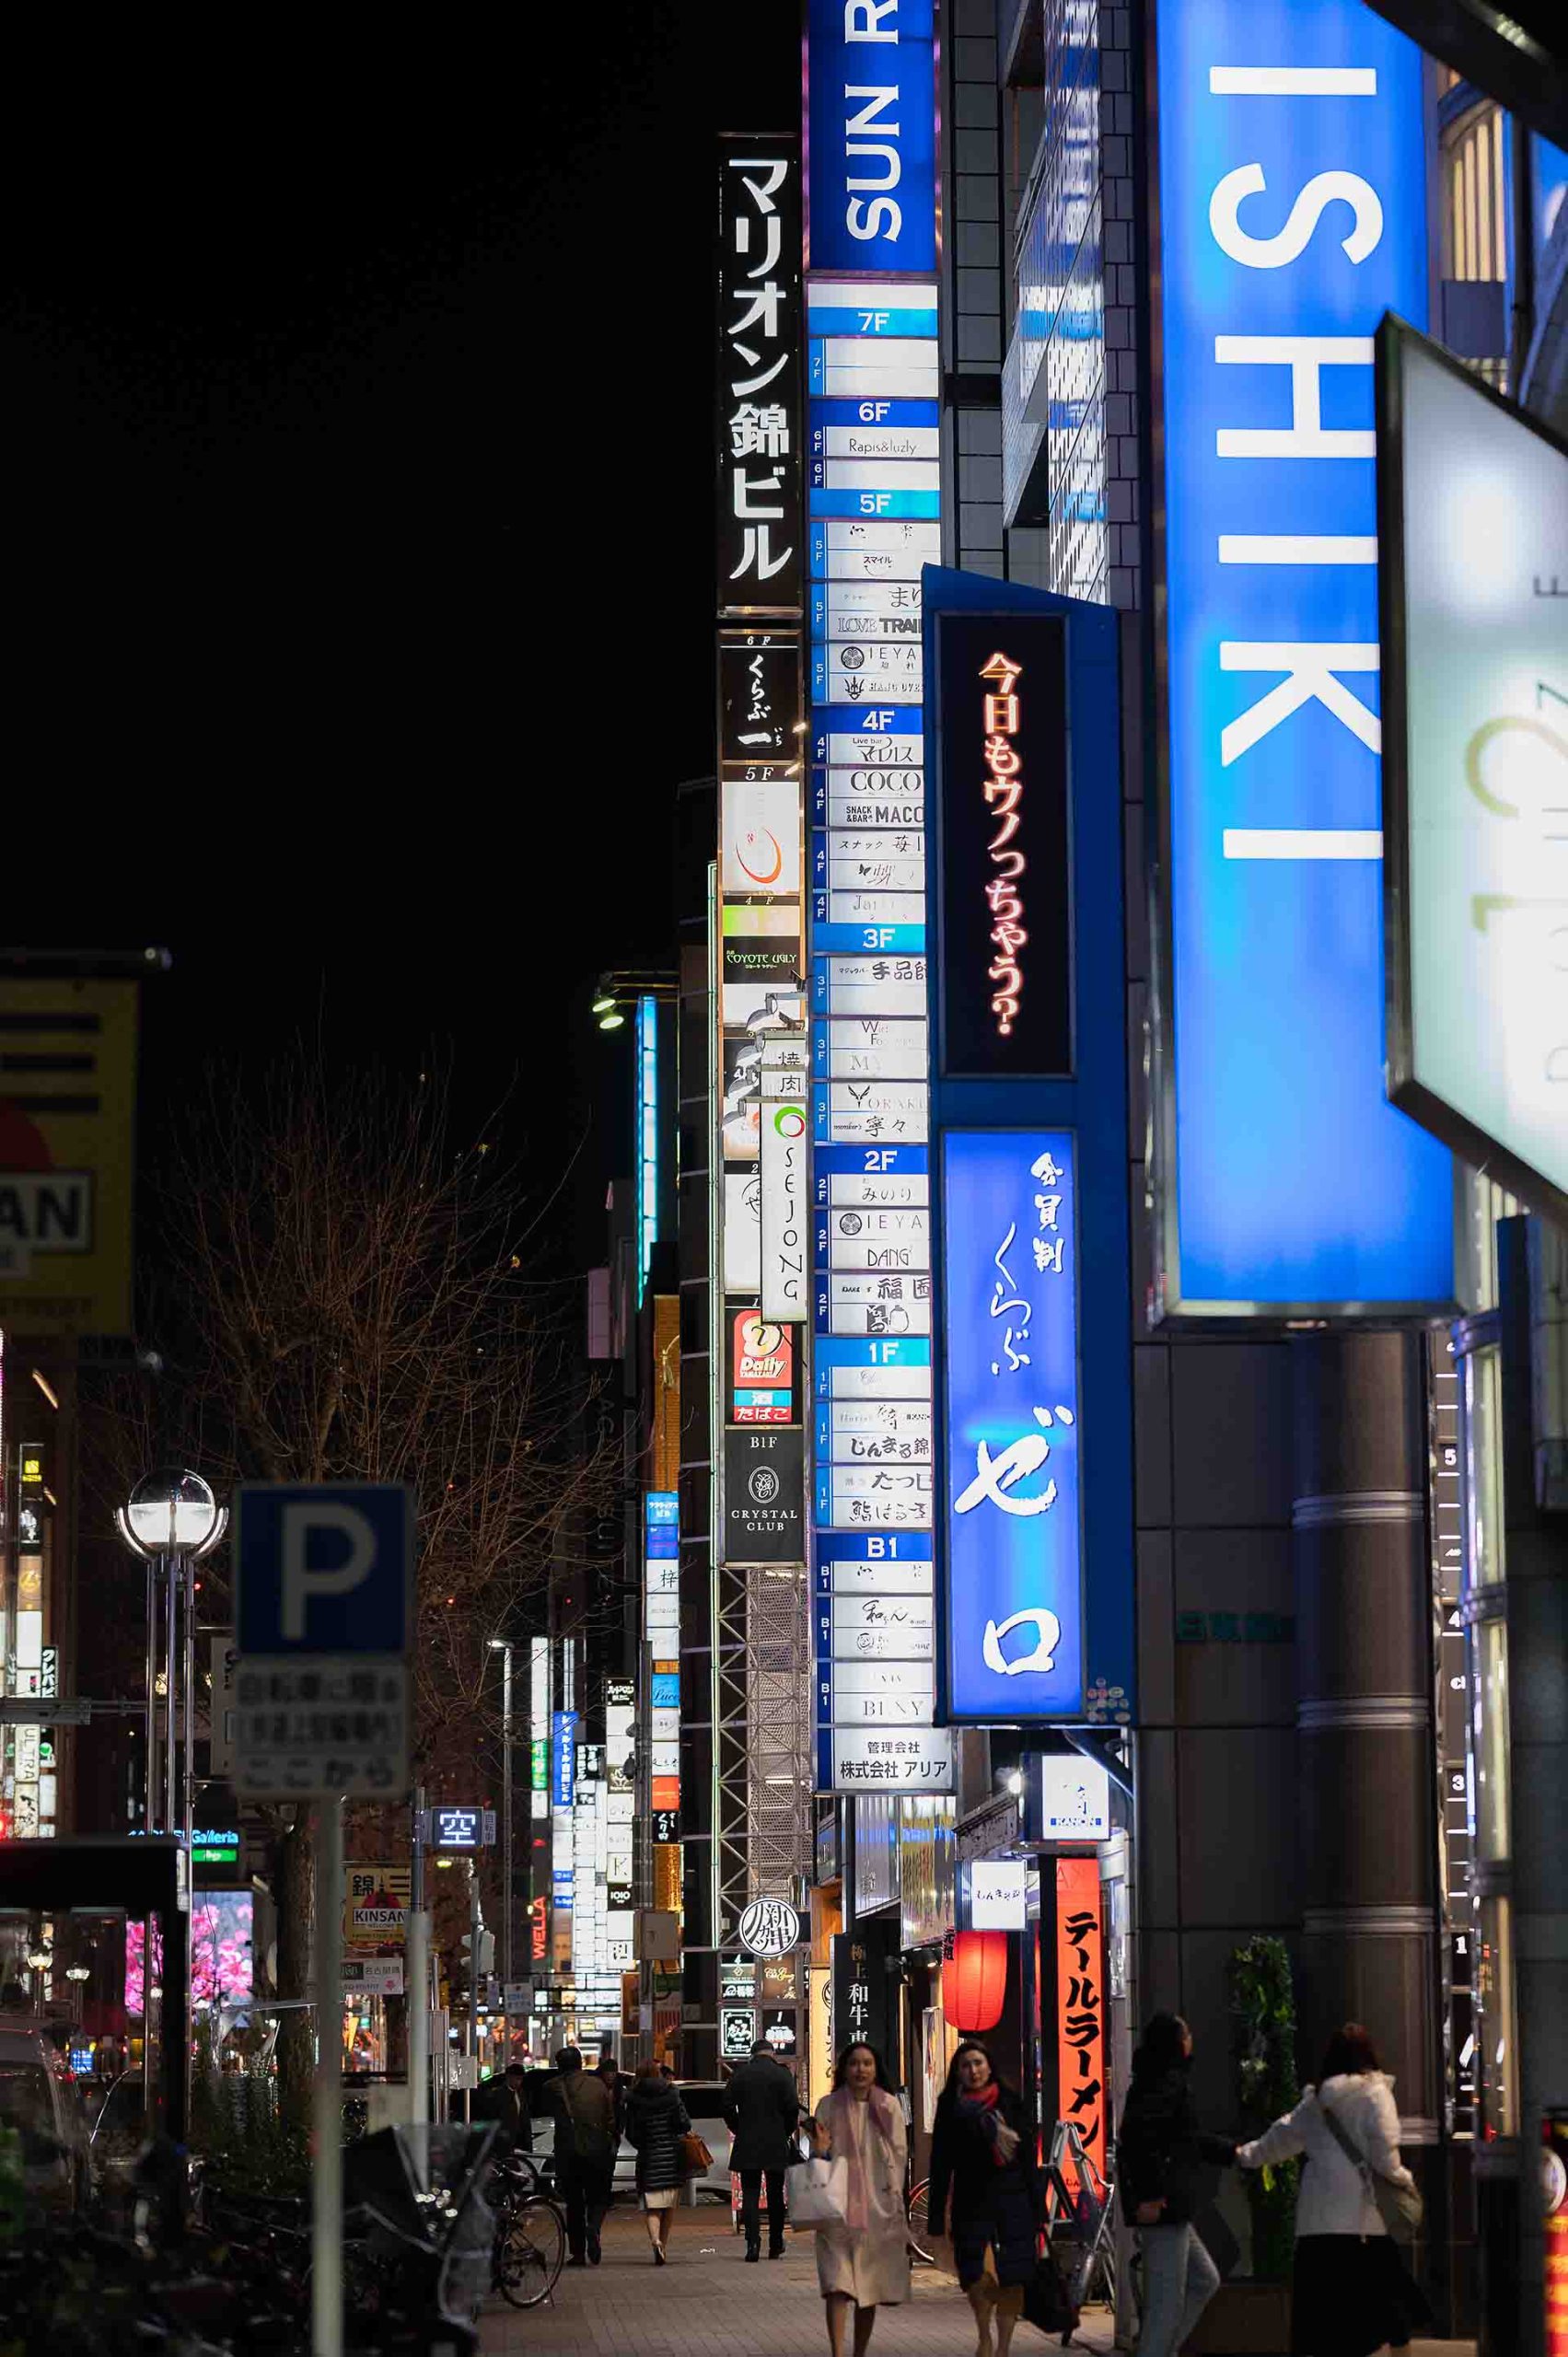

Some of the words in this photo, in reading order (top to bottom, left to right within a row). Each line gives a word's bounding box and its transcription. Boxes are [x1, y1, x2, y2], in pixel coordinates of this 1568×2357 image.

[844, 84, 902, 242] SUN
[857, 312, 890, 332] 7F
[727, 158, 794, 581] マリオン錦ビル
[813, 356, 821, 378] 7F
[858, 401, 891, 422] 6F
[814, 430, 822, 451] 6F
[814, 463, 822, 484] 6F
[859, 493, 892, 514] 5F
[815, 540, 823, 561] 5F
[863, 555, 892, 564] スマイル
[815, 601, 823, 622] 5F
[816, 663, 824, 685] 5F
[862, 710, 896, 731] 4F
[816, 737, 825, 758] 4F
[745, 767, 773, 781] 5F
[850, 771, 922, 791] COCO
[816, 787, 825, 810] 4F
[846, 806, 872, 814] SNACK
[839, 840, 883, 850] スナック
[816, 851, 825, 873] 4F
[816, 896, 825, 918] 4F
[862, 928, 896, 948] 3F
[726, 954, 769, 964] COYOTE
[772, 954, 797, 964] UGLY
[817, 976, 826, 997] 3F
[817, 1039, 826, 1060] 3F
[818, 1102, 827, 1124] 3F
[865, 1150, 898, 1171] 2F
[818, 1178, 827, 1201] 2F
[866, 1214, 923, 1229] IEYA
[1030, 1151, 1065, 1274] 会員制
[779, 1146, 803, 1301] SEJONG
[818, 1229, 827, 1252] 2F
[818, 1294, 827, 1317] 2F
[990, 1221, 1032, 1376] くらぶ
[868, 1341, 900, 1364] 1F
[819, 1371, 828, 1394] 1F
[738, 1407, 789, 1421] たばこ
[819, 1422, 828, 1445] 1F
[1444, 1449, 1457, 1466] 5
[819, 1487, 828, 1510] 1F
[731, 1509, 798, 1519] CRYSTAL
[747, 1522, 784, 1531] CLUB
[866, 1537, 899, 1559] B1
[280, 1501, 377, 1642] P
[820, 1566, 830, 1589] B1
[820, 1618, 830, 1641] B1
[820, 1683, 830, 1706] B1
[867, 1741, 921, 1754] 管理会社
[841, 1760, 900, 1780] 株式会社
[904, 1760, 947, 1778] アリア
[1452, 1774, 1465, 1791] 3
[439, 1809, 476, 1845] 空
[354, 1910, 404, 1922] KINSAN
[532, 1897, 547, 1960] WELLA
[1064, 1910, 1101, 2150] テールラーメン
